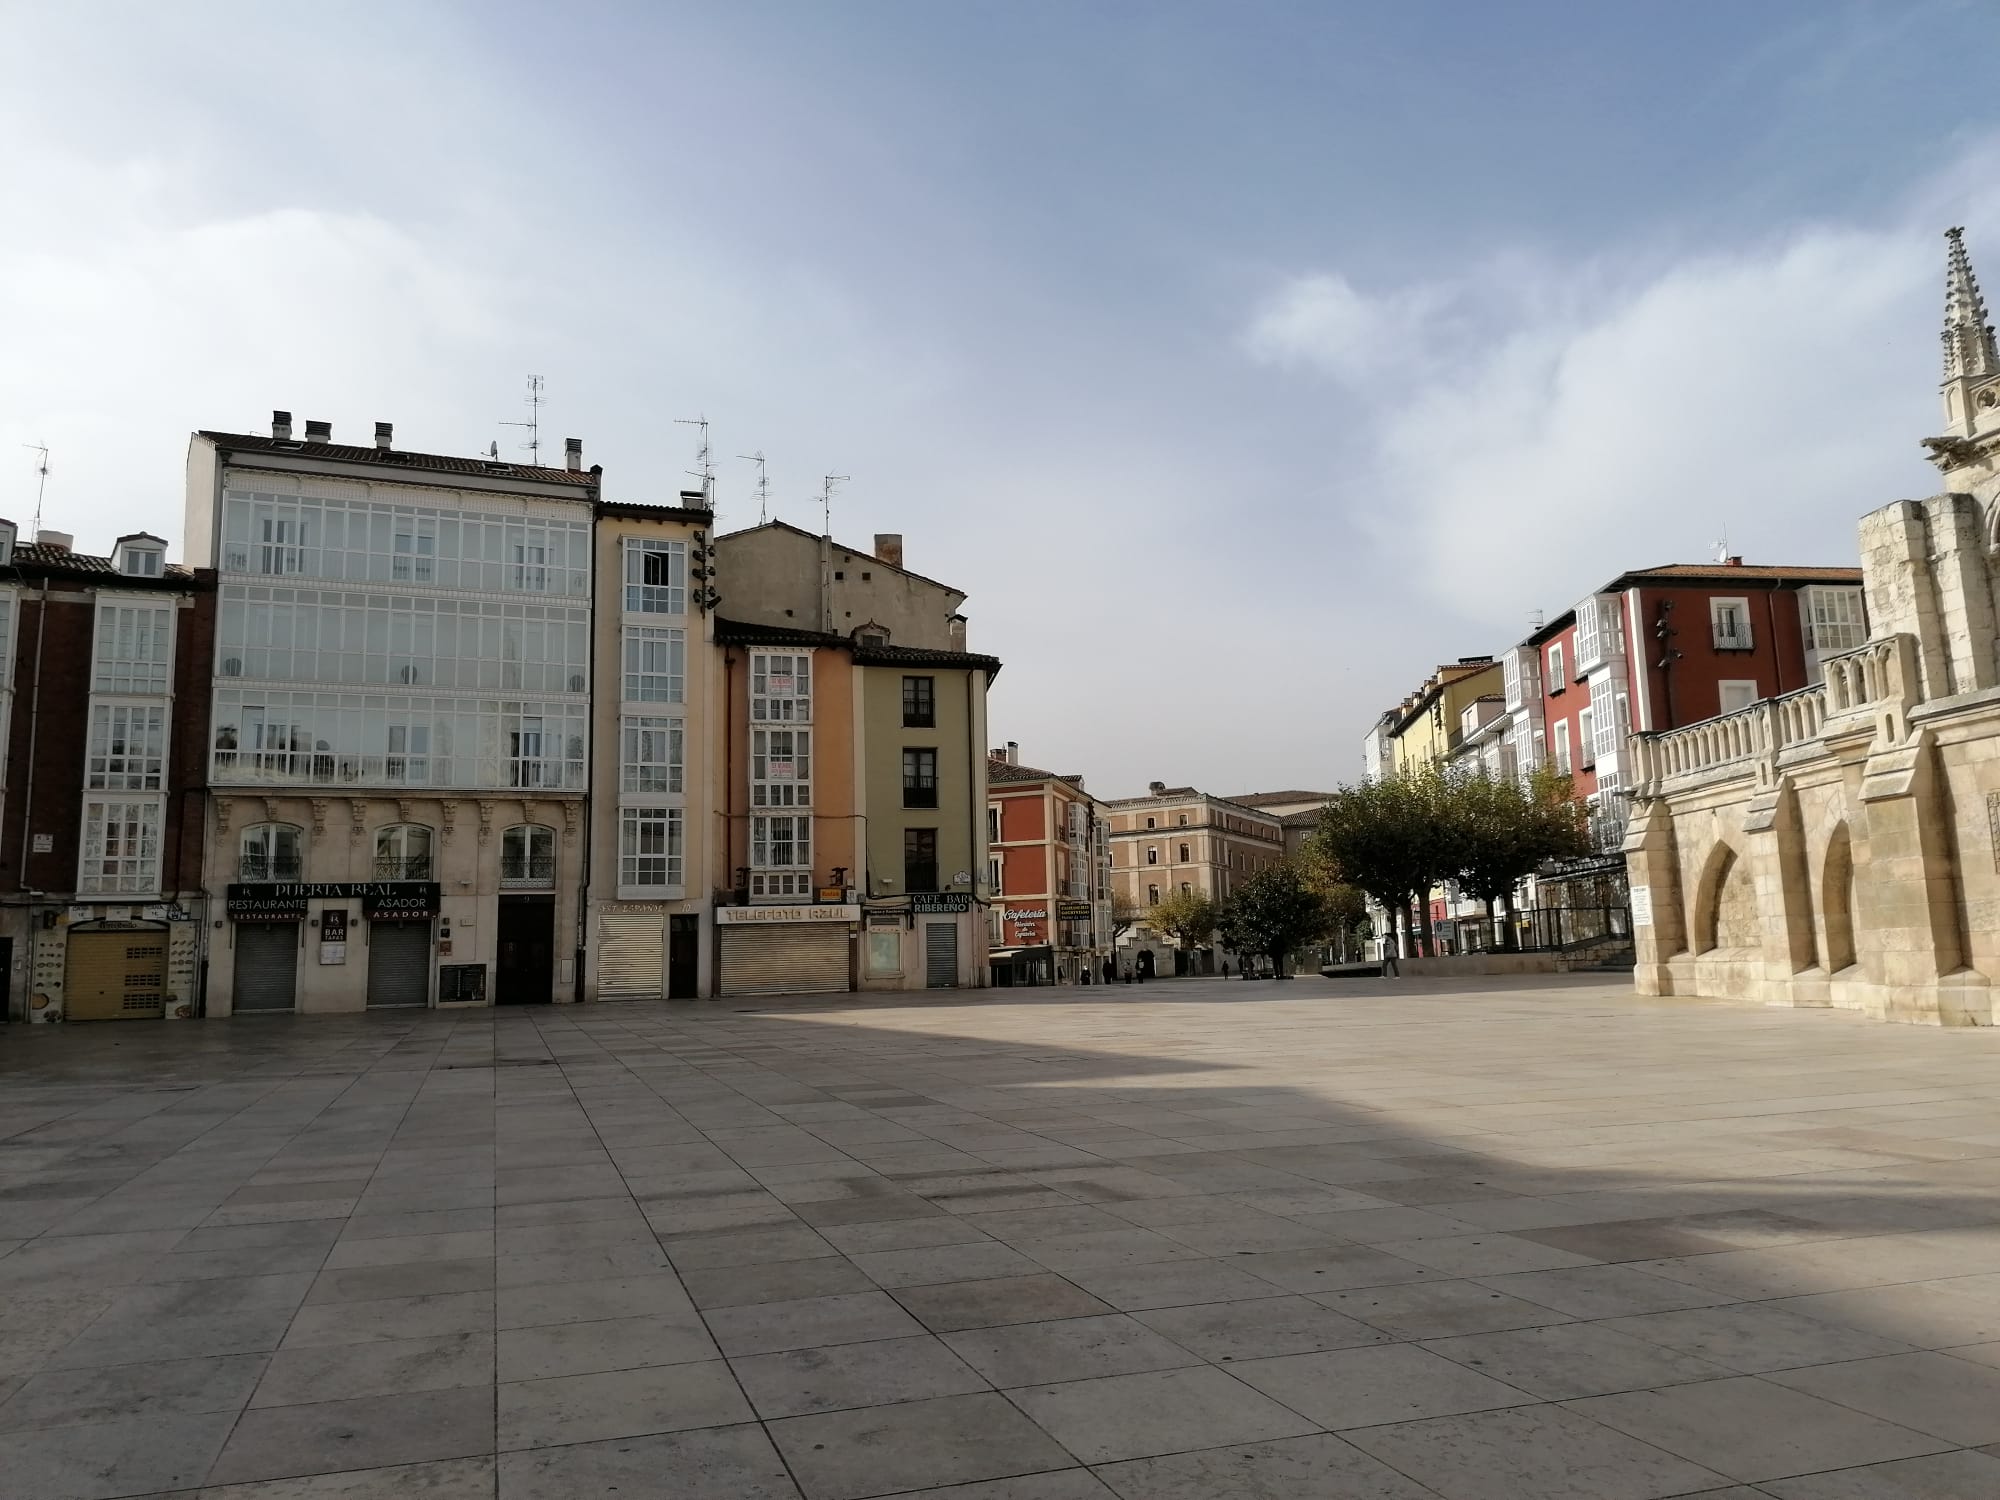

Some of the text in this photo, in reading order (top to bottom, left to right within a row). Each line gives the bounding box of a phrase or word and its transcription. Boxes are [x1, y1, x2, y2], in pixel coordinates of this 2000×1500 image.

[275, 883, 397, 897] PUERTA REAL
[377, 898, 427, 908] ASADOR
[946, 894, 969, 904] BAR
[228, 899, 307, 910] RESTAURANTE
[233, 912, 305, 920] RESTAURANTE
[727, 906, 850, 922] TELEFOTO AZUL
[1003, 909, 1047, 921] Cafetería
[325, 928, 344, 936] BAR
